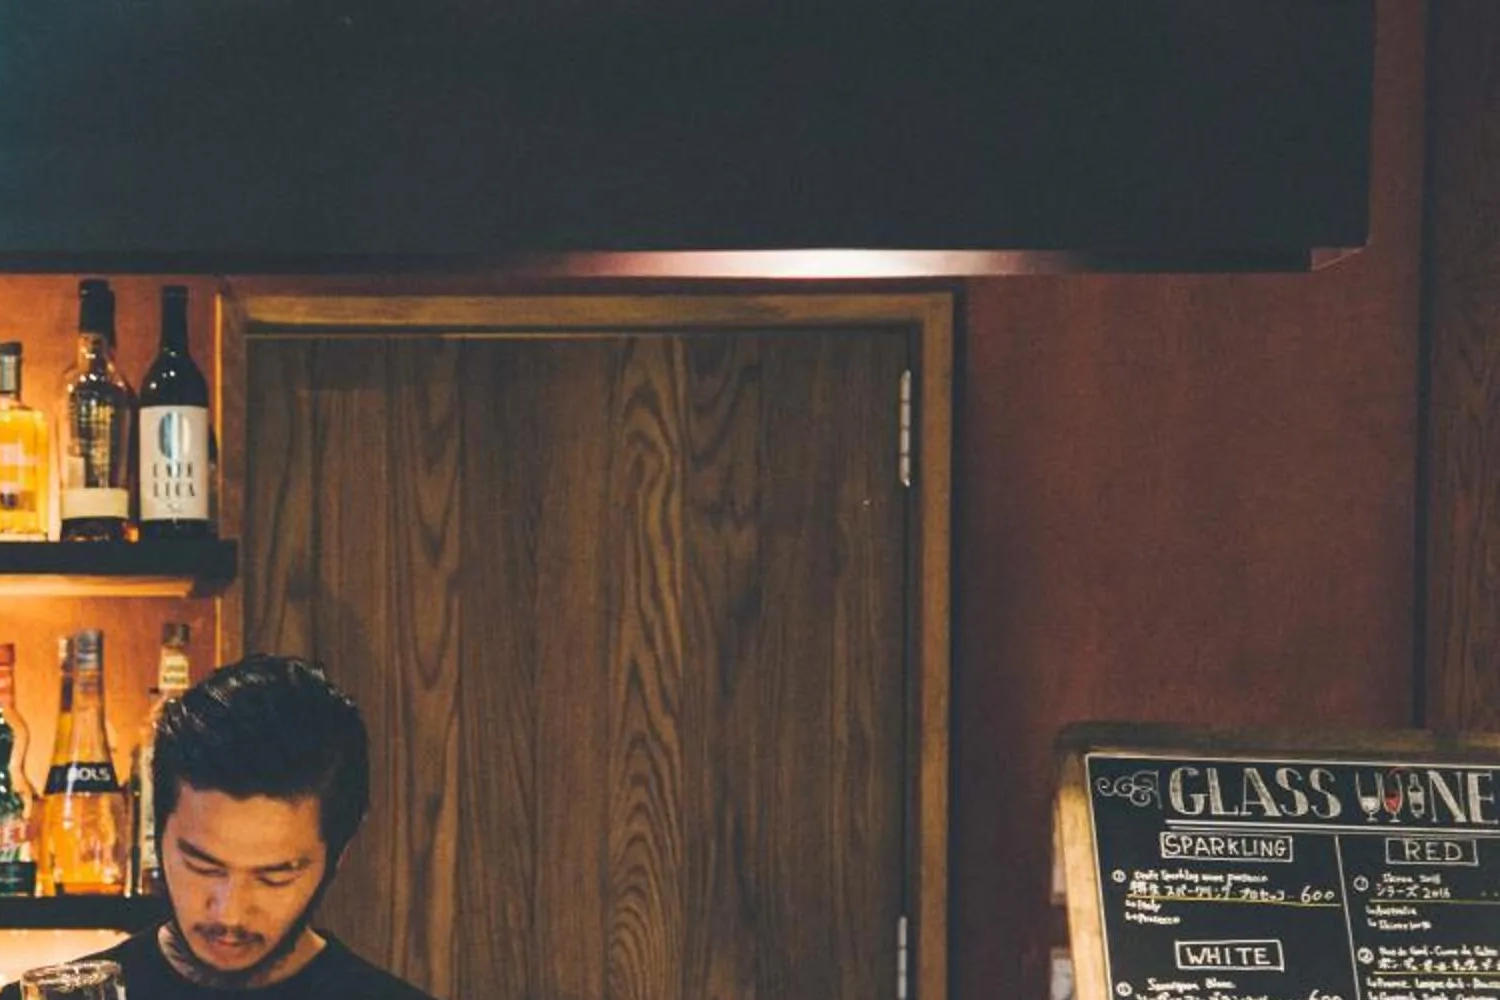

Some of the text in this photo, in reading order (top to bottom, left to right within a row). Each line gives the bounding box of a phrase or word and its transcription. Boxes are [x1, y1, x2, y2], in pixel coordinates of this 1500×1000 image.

[1168, 766, 1343, 820] GLASS
[1163, 836, 1288, 858] SPARKLING
[1402, 841, 1464, 862] RED
[1300, 884, 1336, 903] 600
[1185, 946, 1272, 966] WHITE
